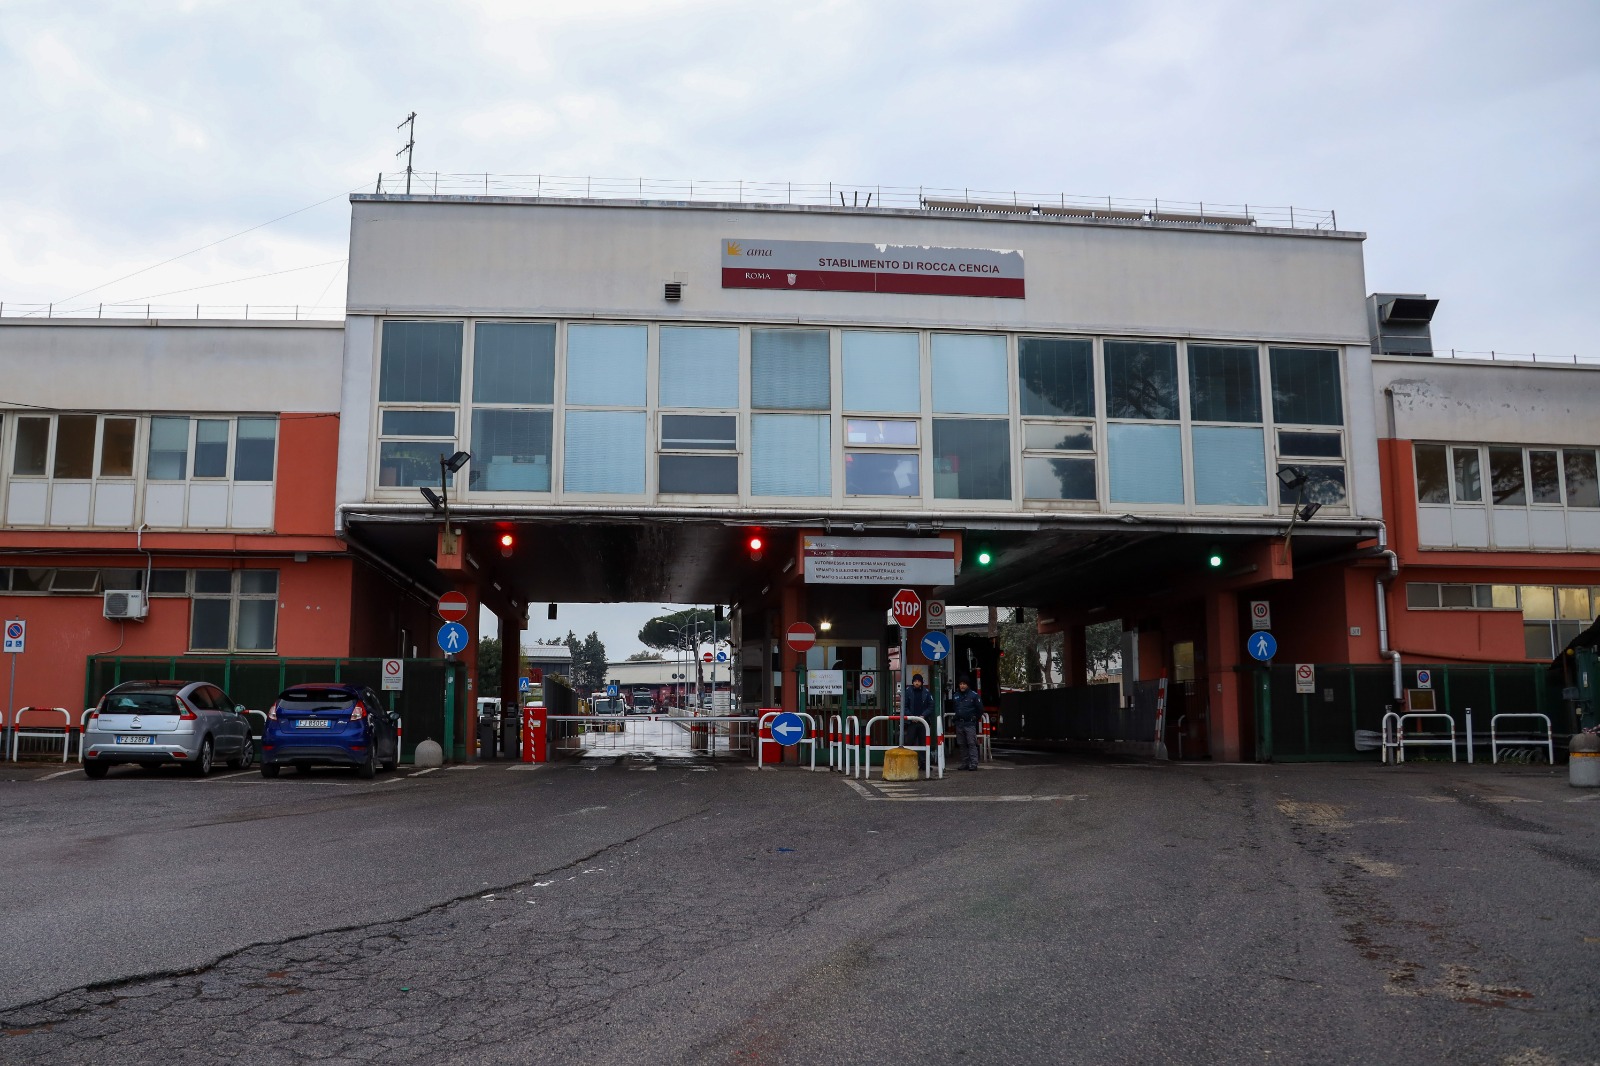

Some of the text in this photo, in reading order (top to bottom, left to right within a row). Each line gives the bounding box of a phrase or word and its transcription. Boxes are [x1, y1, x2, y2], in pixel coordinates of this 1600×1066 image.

[746, 247, 773, 257] ama
[818, 257, 1000, 274] STABILIMENTO DI ROCCA CENCIA
[745, 272, 771, 281] ROMA
[894, 601, 920, 616] STOP
[932, 605, 940, 613] 10
